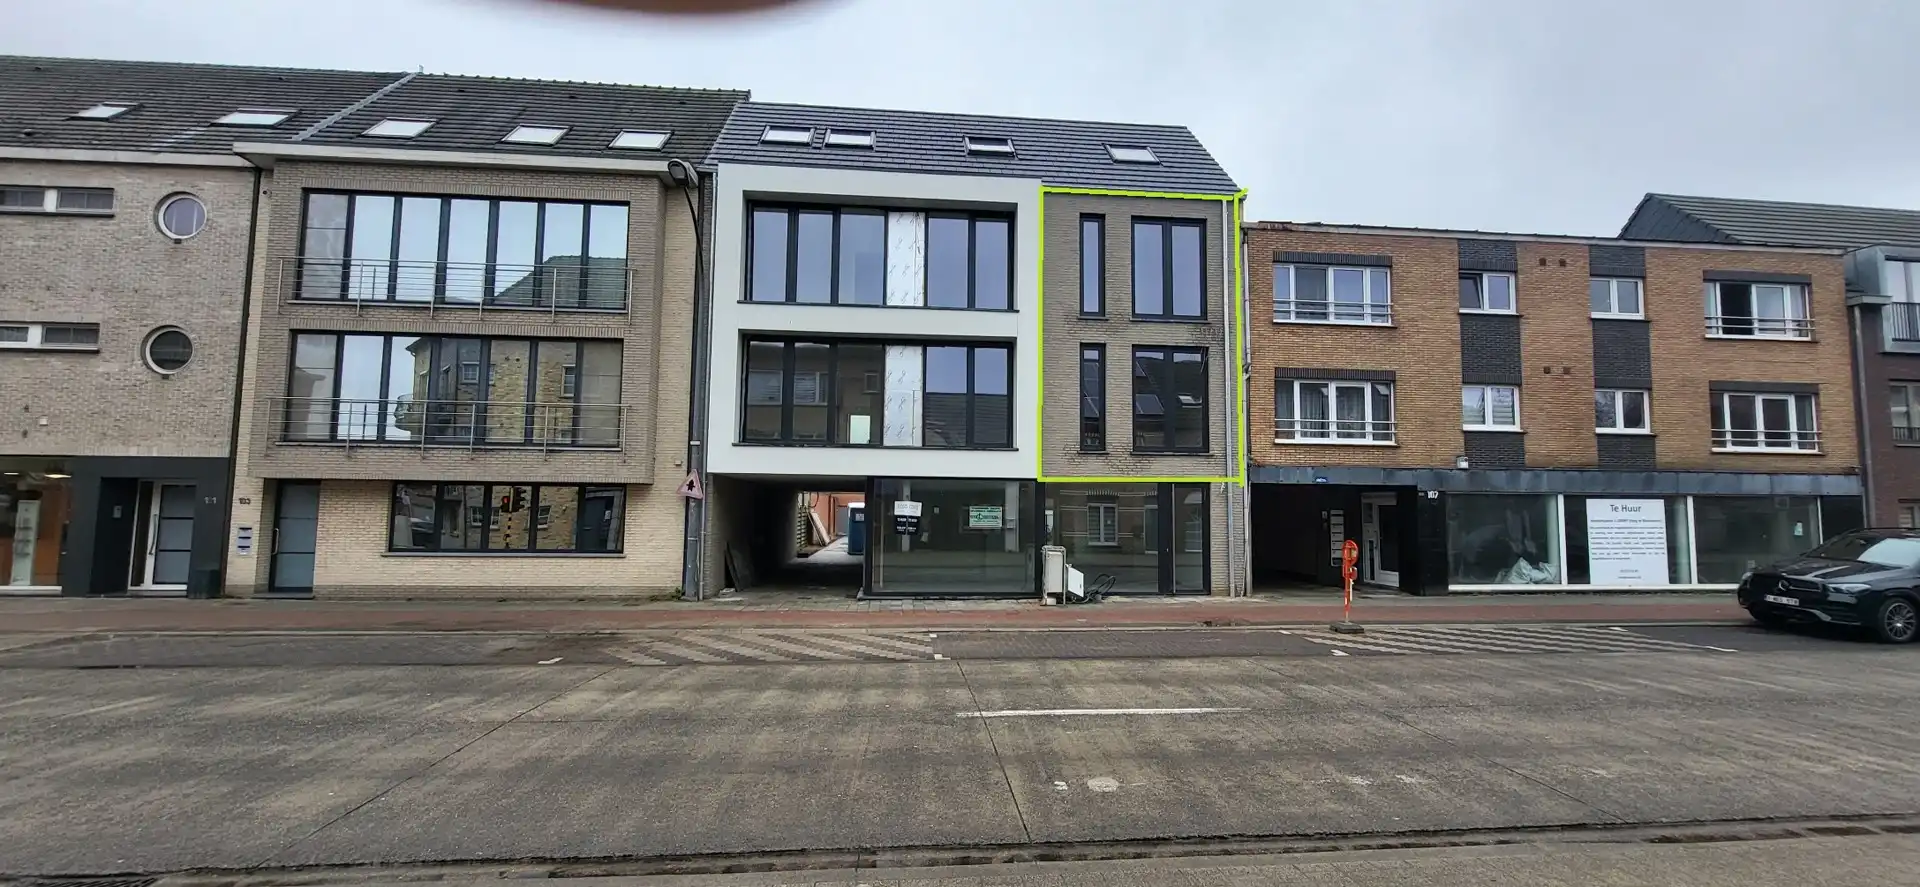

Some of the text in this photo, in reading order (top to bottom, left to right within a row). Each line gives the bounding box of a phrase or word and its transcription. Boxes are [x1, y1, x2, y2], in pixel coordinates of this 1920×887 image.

[1427, 490, 1439, 499] 107
[1610, 504, 1642, 512] Te Huur
